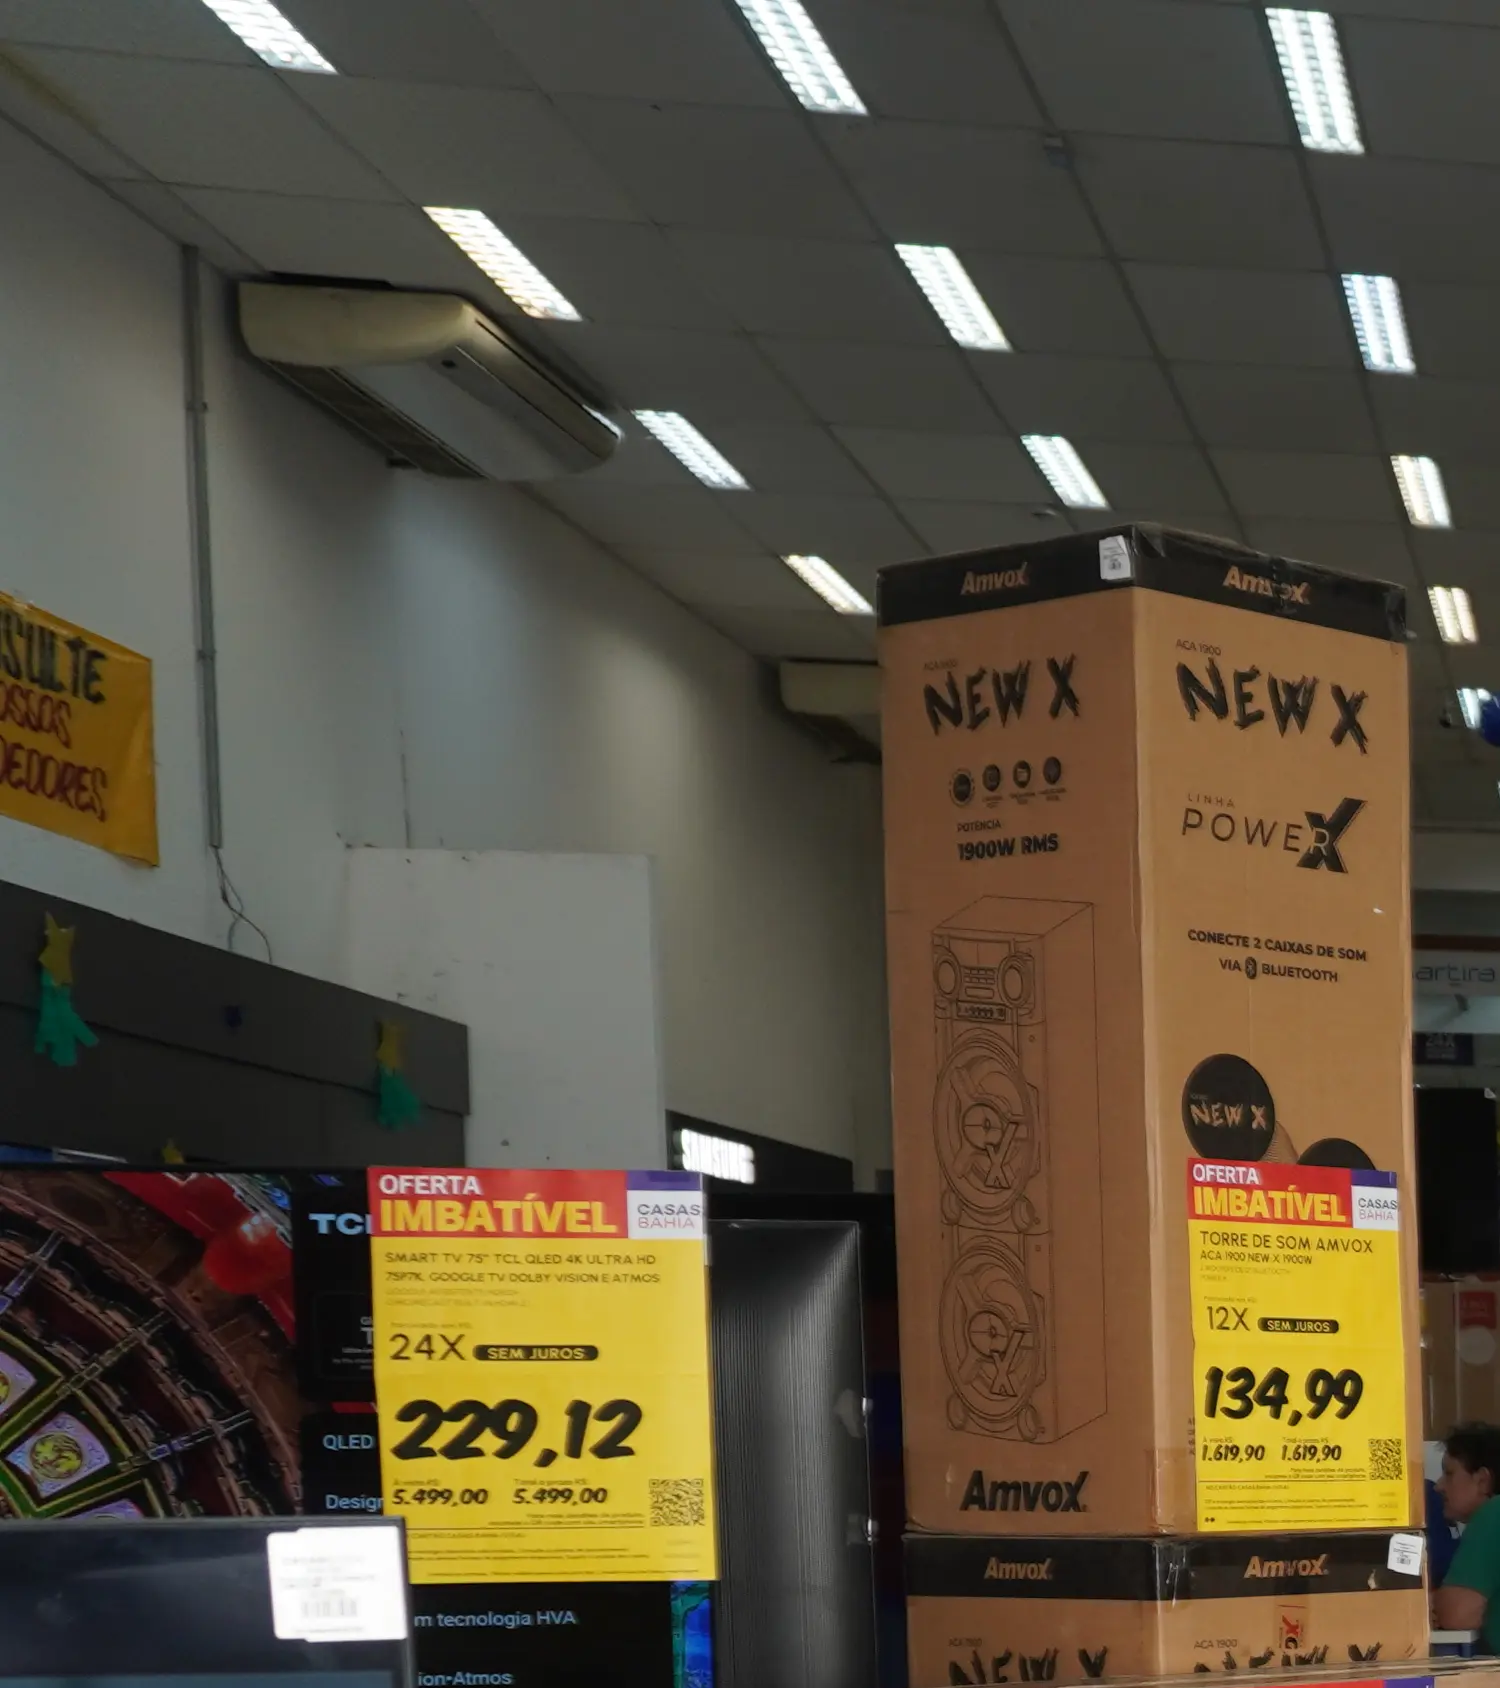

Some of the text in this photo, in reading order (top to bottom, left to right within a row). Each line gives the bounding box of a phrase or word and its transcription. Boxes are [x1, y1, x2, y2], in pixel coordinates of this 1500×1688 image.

[961, 562, 1030, 596] Amvox
[1176, 657, 1368, 754] NEW X
[958, 834, 1059, 861] 1900W RMS
[1187, 929, 1367, 962] CONECTE 2 CAIXAS DE SOM
[1219, 958, 1338, 983] VIA BLUETOOTH
[379, 1175, 482, 1196] OFERTA
[1192, 1163, 1262, 1187] OFERTA
[380, 1193, 619, 1234] IMBATÍVEL
[1194, 1184, 1347, 1223] IMBATÍVEL
[1357, 1197, 1398, 1212] CASAS
[1358, 1209, 1395, 1221] BAHIA
[1200, 1231, 1373, 1254] TORRE DE SOM AMVOX
[385, 1252, 438, 1264] SMART
[442, 1253, 463, 1264] TV
[494, 1253, 521, 1265] TCL
[525, 1253, 562, 1266] QLED
[566, 1254, 582, 1265] 4K
[586, 1254, 633, 1265] ULTRA
[637, 1255, 655, 1265] HD
[389, 1334, 585, 1361] 24X SEM JUROS
[1203, 1364, 1363, 1426] 134,99
[390, 1398, 643, 1468] 229,12
[391, 1488, 488, 1505] 5.499,00
[960, 1469, 1090, 1513] Amvox
[436, 1609, 576, 1632] tecnologia HVA
